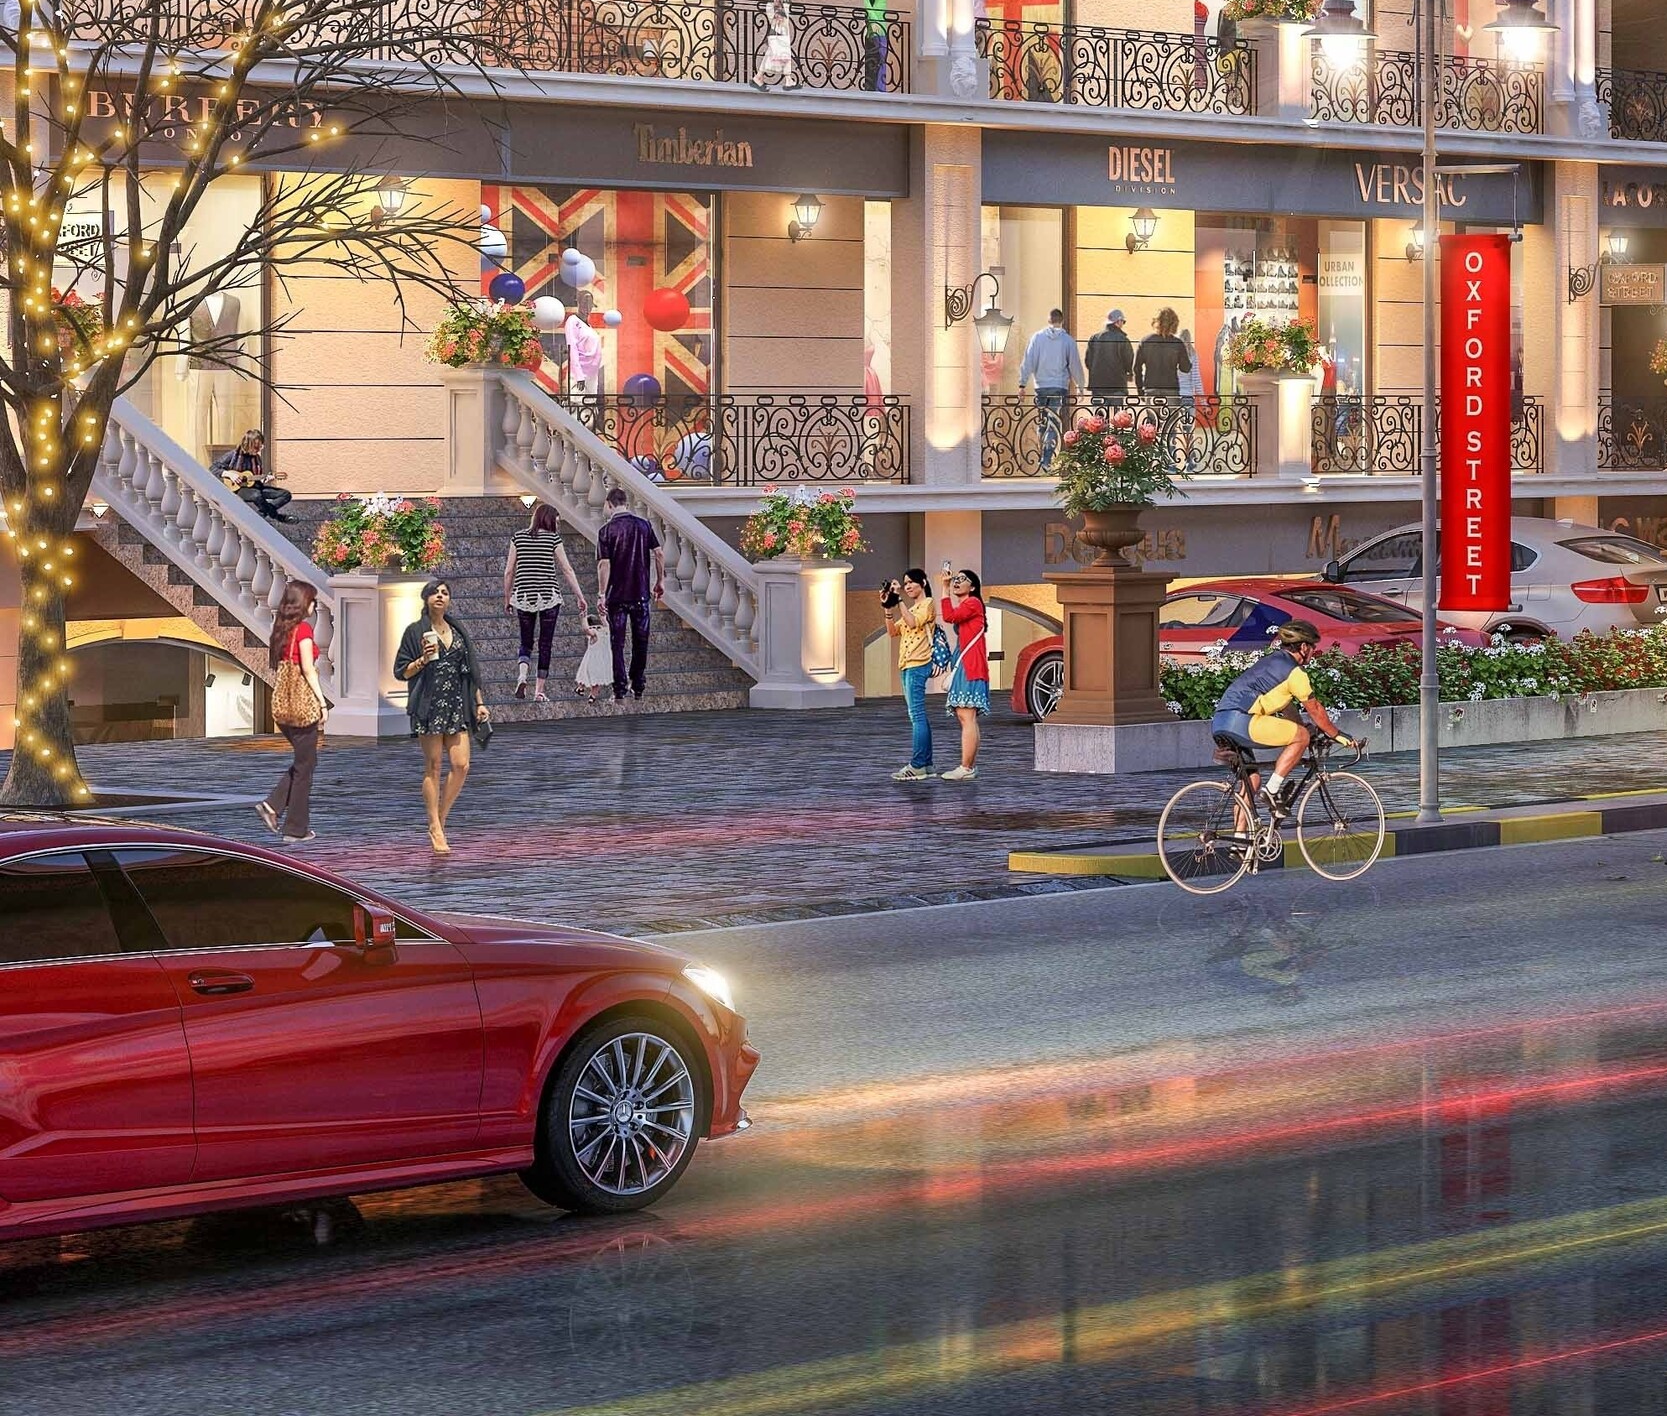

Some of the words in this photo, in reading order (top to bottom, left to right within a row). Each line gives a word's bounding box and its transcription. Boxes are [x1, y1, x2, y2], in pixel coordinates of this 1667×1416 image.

[1108, 146, 1176, 184] DIESEL
[1115, 185, 1177, 196] DIVISION
[1324, 261, 1355, 272] URBAN
[1607, 272, 1658, 284] OXFORD
[1607, 286, 1653, 298] STREET
[1465, 251, 1483, 416] OXFORD
[1466, 431, 1482, 596] STREET
